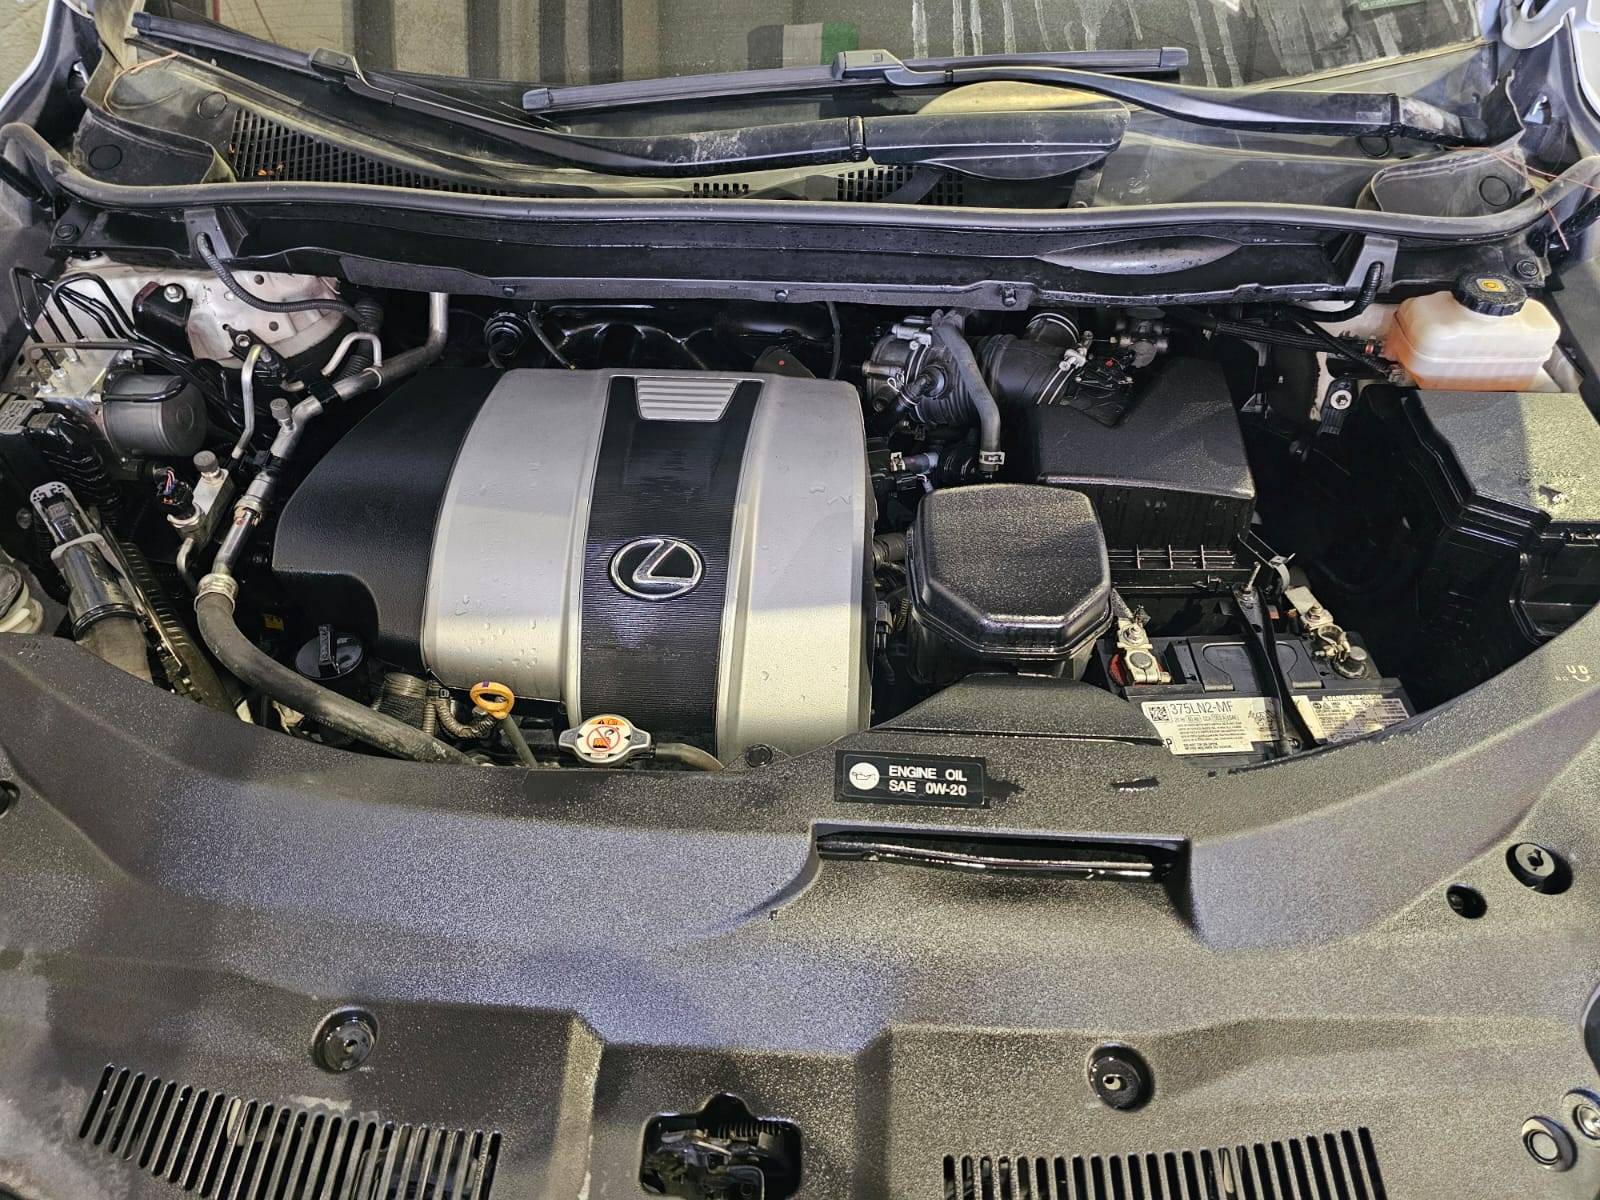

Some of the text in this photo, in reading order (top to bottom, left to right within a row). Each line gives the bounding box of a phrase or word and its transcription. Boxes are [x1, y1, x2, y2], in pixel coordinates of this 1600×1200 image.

[1170, 701, 1233, 715] 375LN2-MF
[888, 765, 967, 782] ENGINE OIL
[888, 780, 967, 796] SAE 0W-20
